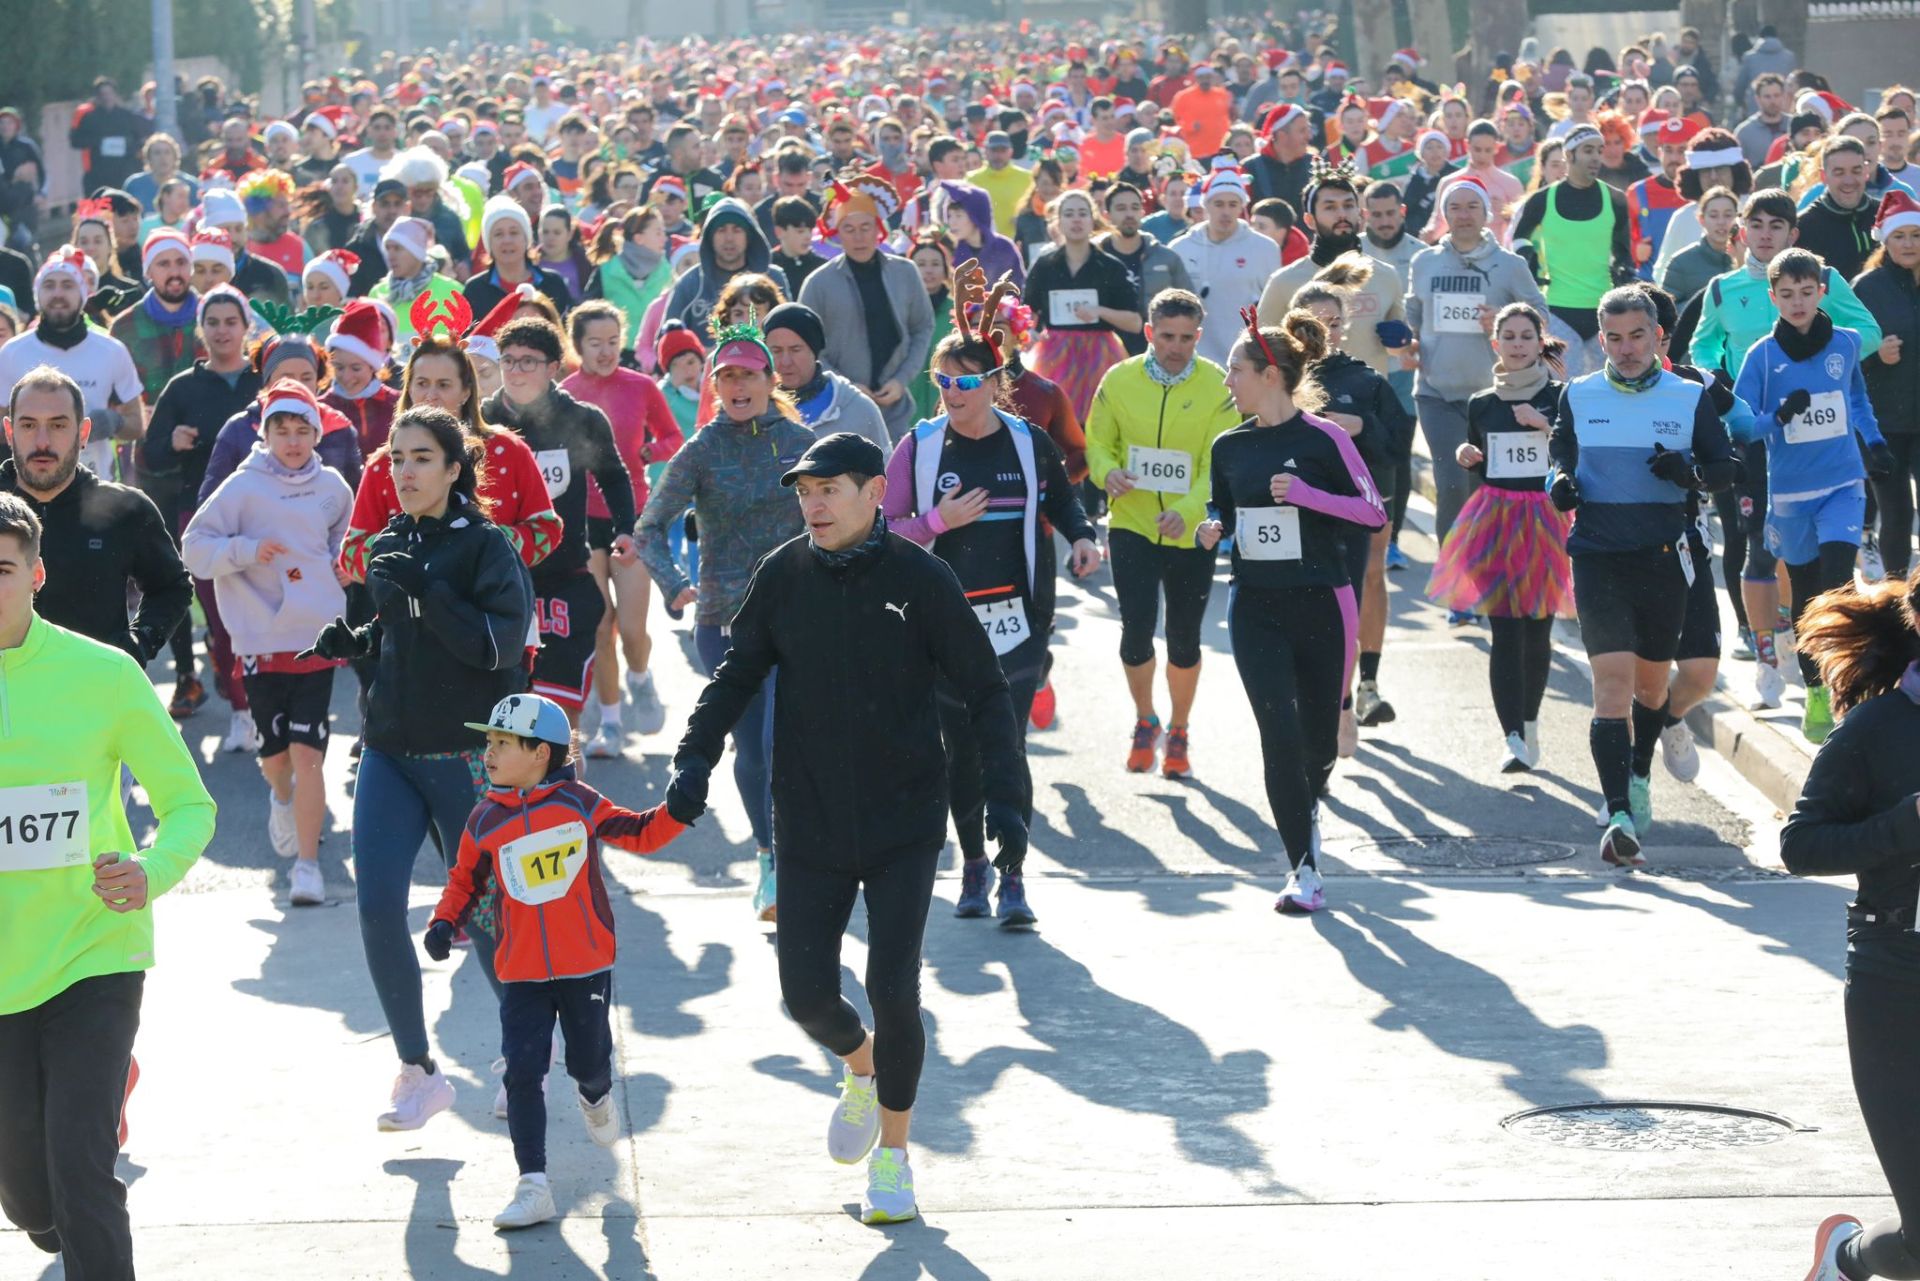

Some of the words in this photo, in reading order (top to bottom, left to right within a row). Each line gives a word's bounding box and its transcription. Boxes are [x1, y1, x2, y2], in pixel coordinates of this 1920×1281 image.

[1431, 276, 1481, 292] PUMA
[1443, 306, 1480, 320] 2662
[1802, 408, 1836, 427] 469
[1506, 447, 1537, 464] 185
[1140, 462, 1185, 479] 1606
[1258, 525, 1281, 544] 53
[0, 810, 80, 844] 1677
